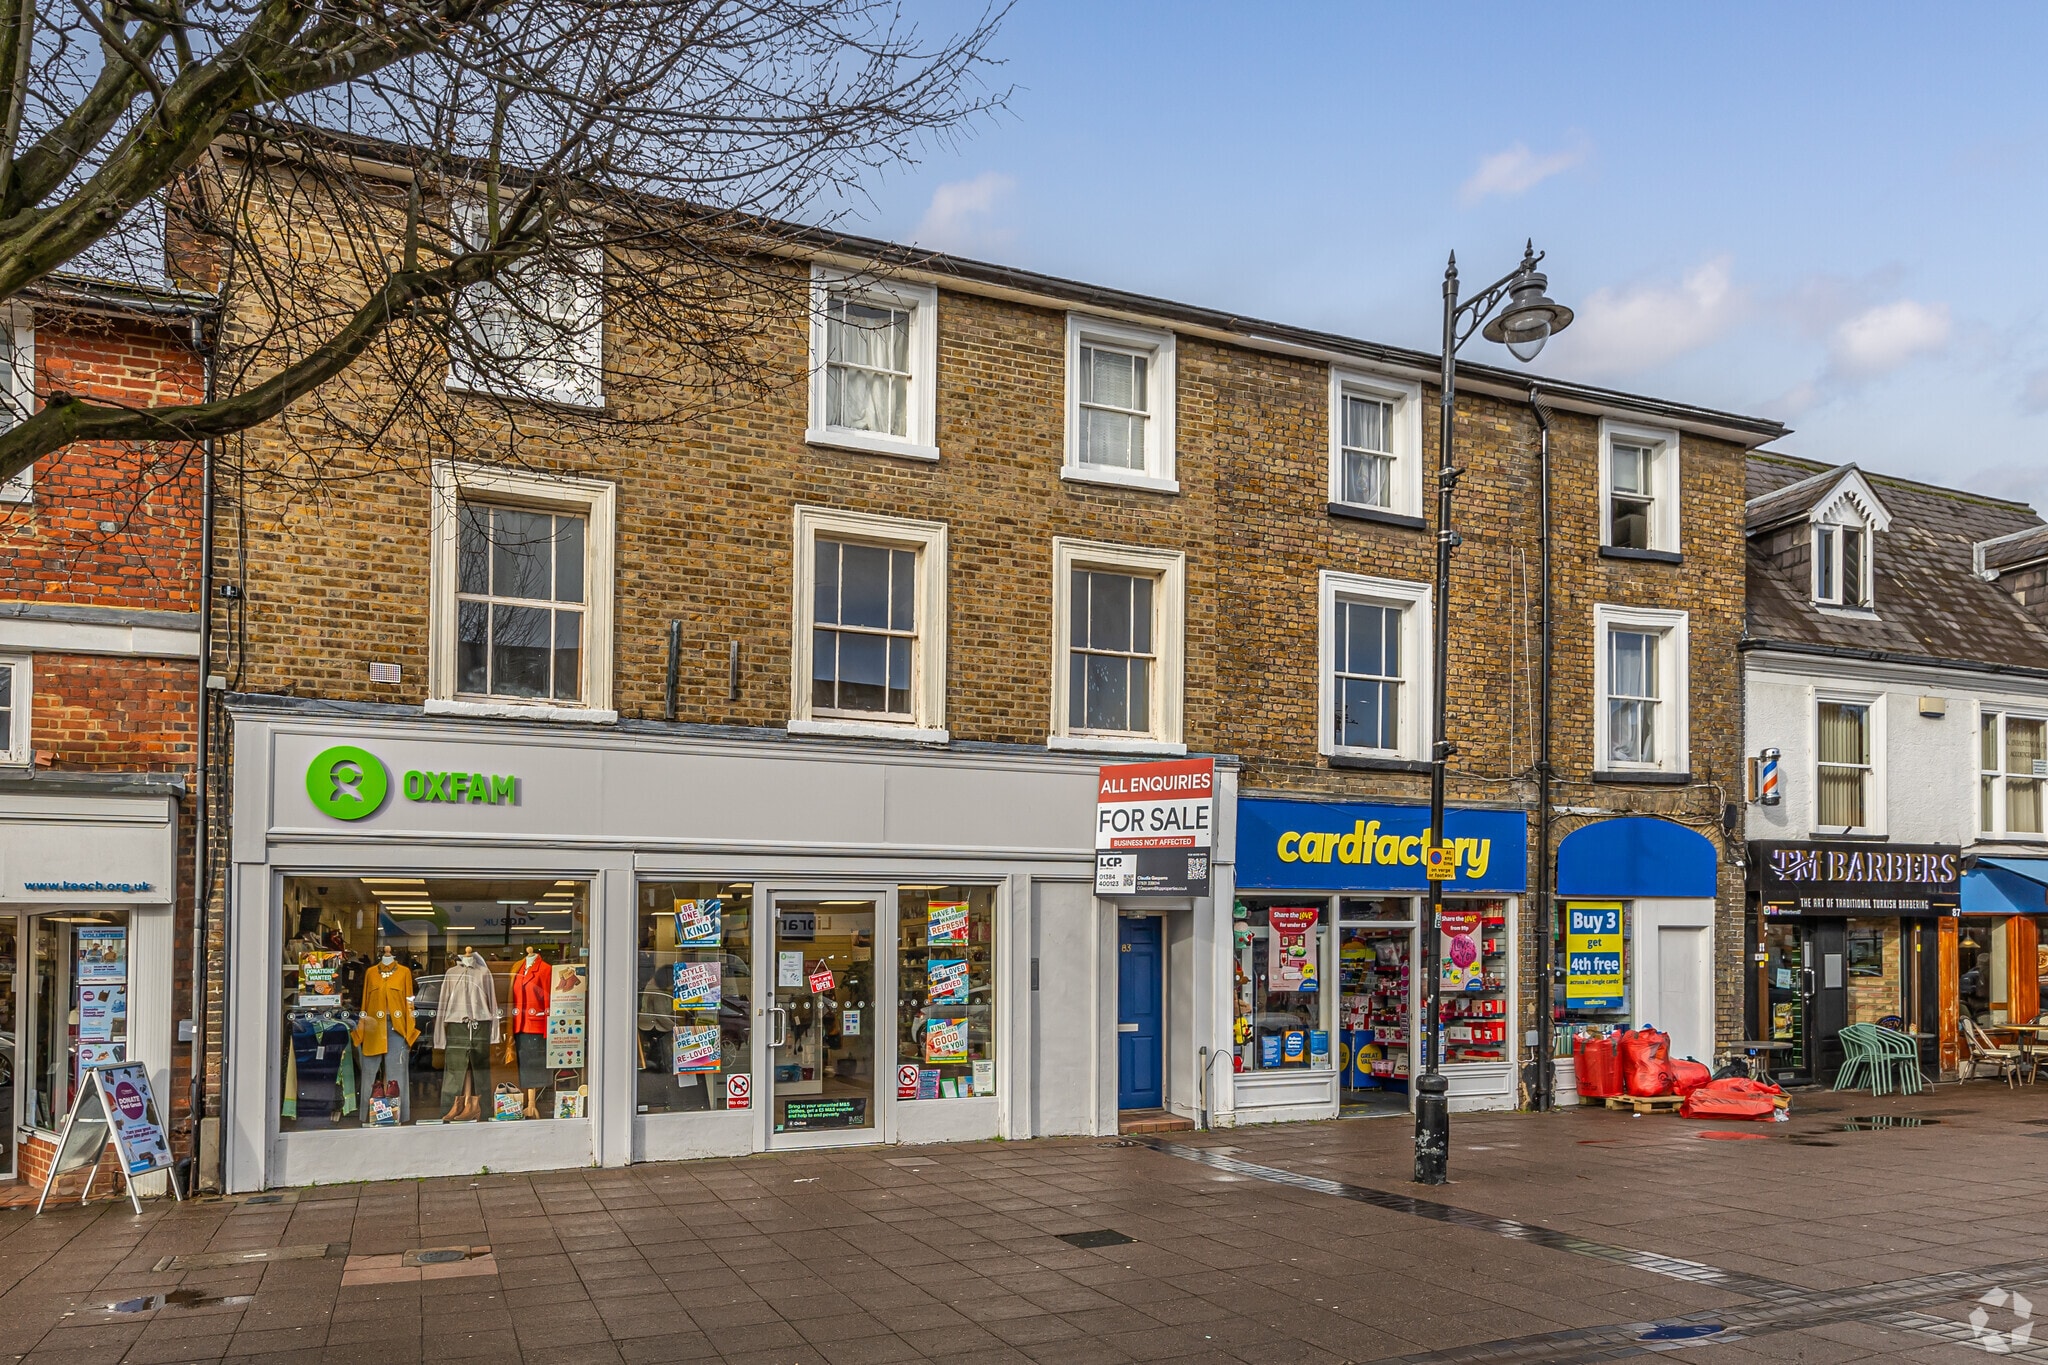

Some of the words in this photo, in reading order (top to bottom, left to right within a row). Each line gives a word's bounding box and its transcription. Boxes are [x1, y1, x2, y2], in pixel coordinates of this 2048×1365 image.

[403, 770, 515, 804] OXFAM
[1100, 778, 1128, 794] ALL
[1130, 773, 1211, 792] ENQUIRIES
[1100, 808, 1145, 832] FOR
[1150, 806, 1209, 831] SALE
[1277, 819, 1491, 879] cardfactry
[1828, 852, 1958, 884] BARBERS
[24, 881, 151, 893] www.keech.org.uk
[683, 904, 692, 912] BE
[1800, 898, 1811, 908] THE
[1813, 898, 1825, 908] ART
[1826, 899, 1833, 908] OF
[1836, 899, 1872, 909] TRADITIONAL
[1874, 900, 1896, 909] TURKISH
[1899, 900, 1928, 910] BARBERING
[682, 911, 698, 921] ONE
[932, 908, 950, 919] HAVE
[940, 911, 966, 923] WARDROBE
[1952, 908, 1960, 917] 87
[931, 920, 964, 934] REFRESH
[1573, 912, 1603, 934] Buy
[1606, 912, 1616, 929] 3
[686, 924, 710, 937] KIND
[1121, 944, 1131, 952] 83
[1587, 938, 1602, 949] get
[1571, 957, 1591, 970] 4th
[1594, 957, 1618, 970] free
[681, 966, 703, 977] STYLE
[931, 965, 965, 980] PRE-LOVED
[689, 980, 703, 988] COST
[816, 981, 830, 990] OPEN
[931, 980, 961, 994] RE-LOVED
[681, 985, 708, 1000] EARTH
[930, 1024, 946, 1032] KIND
[677, 1030, 717, 1048] PRE-LOVED
[934, 1032, 958, 1046] GOOD
[950, 1039, 964, 1049] YOU
[676, 1046, 712, 1063] RE-LOVED
[119, 1096, 140, 1104] DONATE
